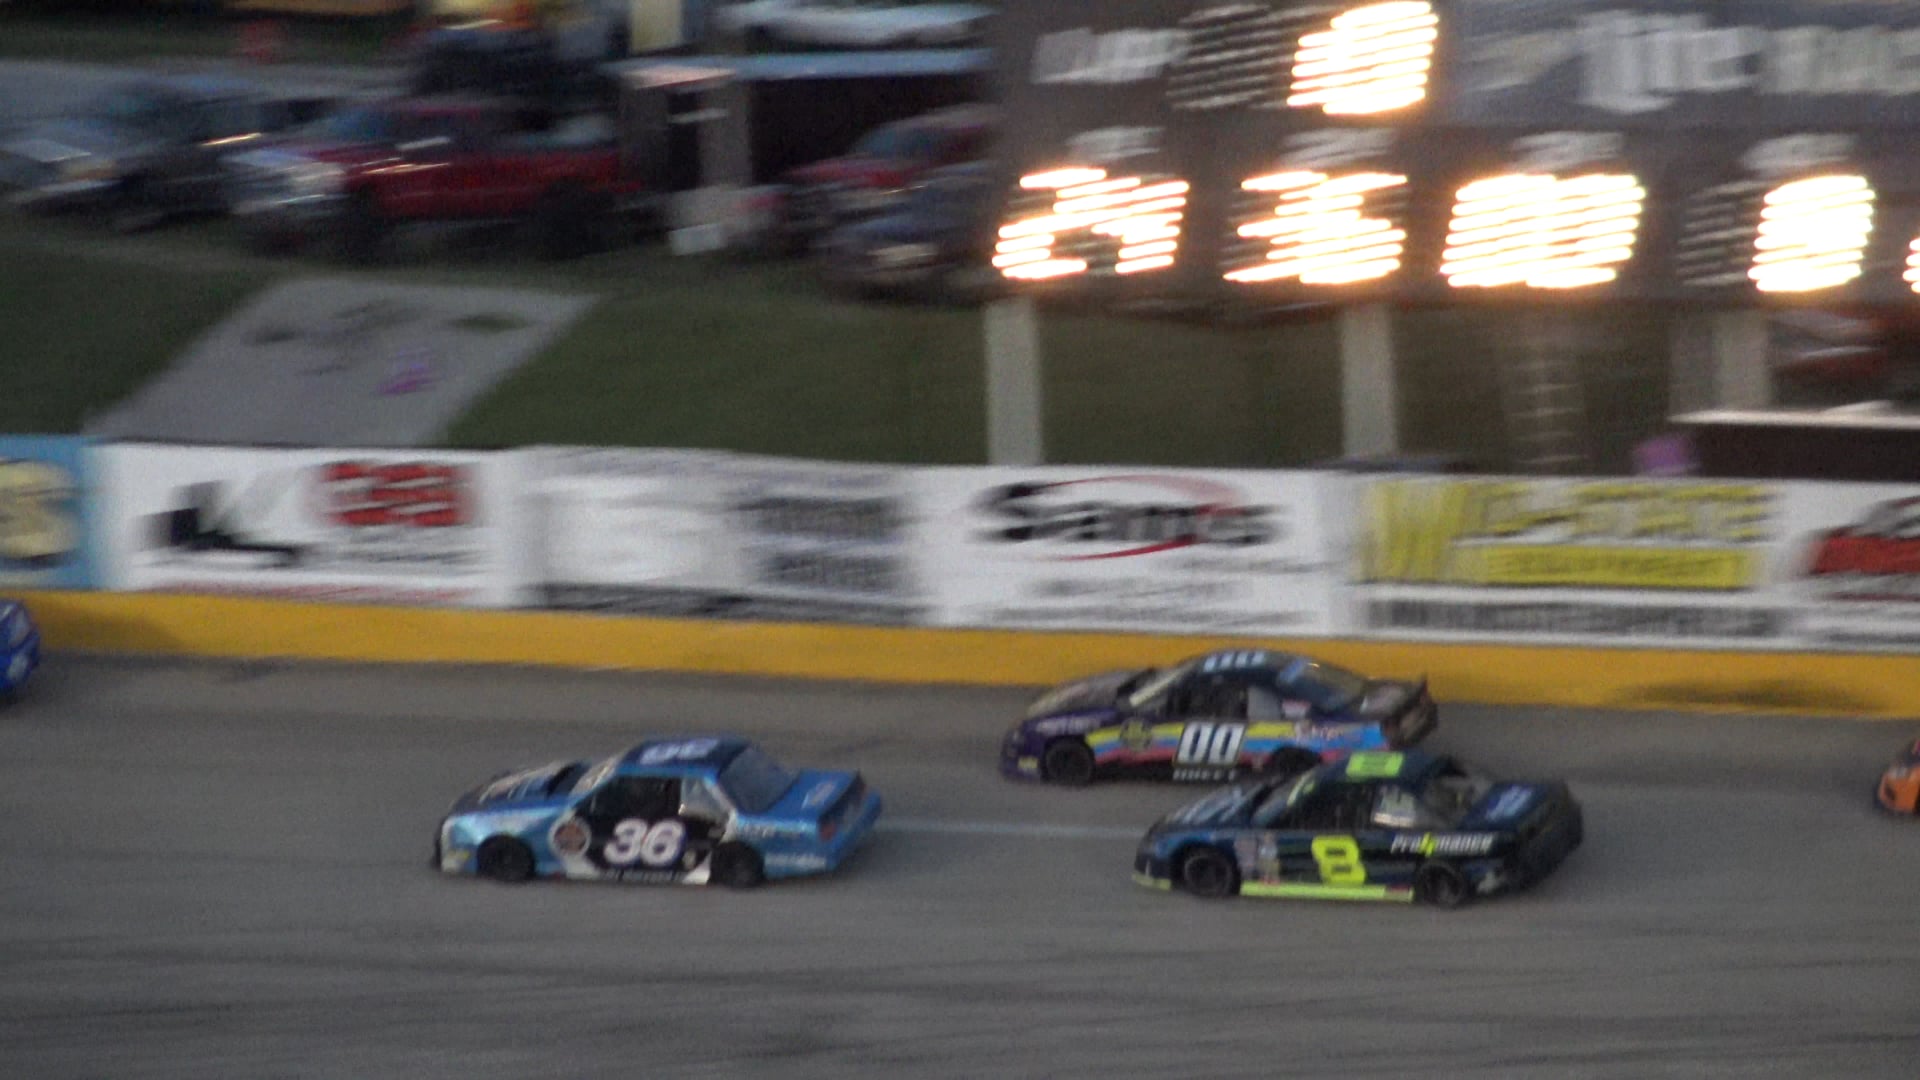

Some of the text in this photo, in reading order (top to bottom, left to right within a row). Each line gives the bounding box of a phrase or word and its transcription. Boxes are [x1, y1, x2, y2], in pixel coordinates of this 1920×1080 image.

[1174, 721, 1246, 765] 00
[602, 818, 688, 868] 36
[1310, 835, 1367, 887] 8
